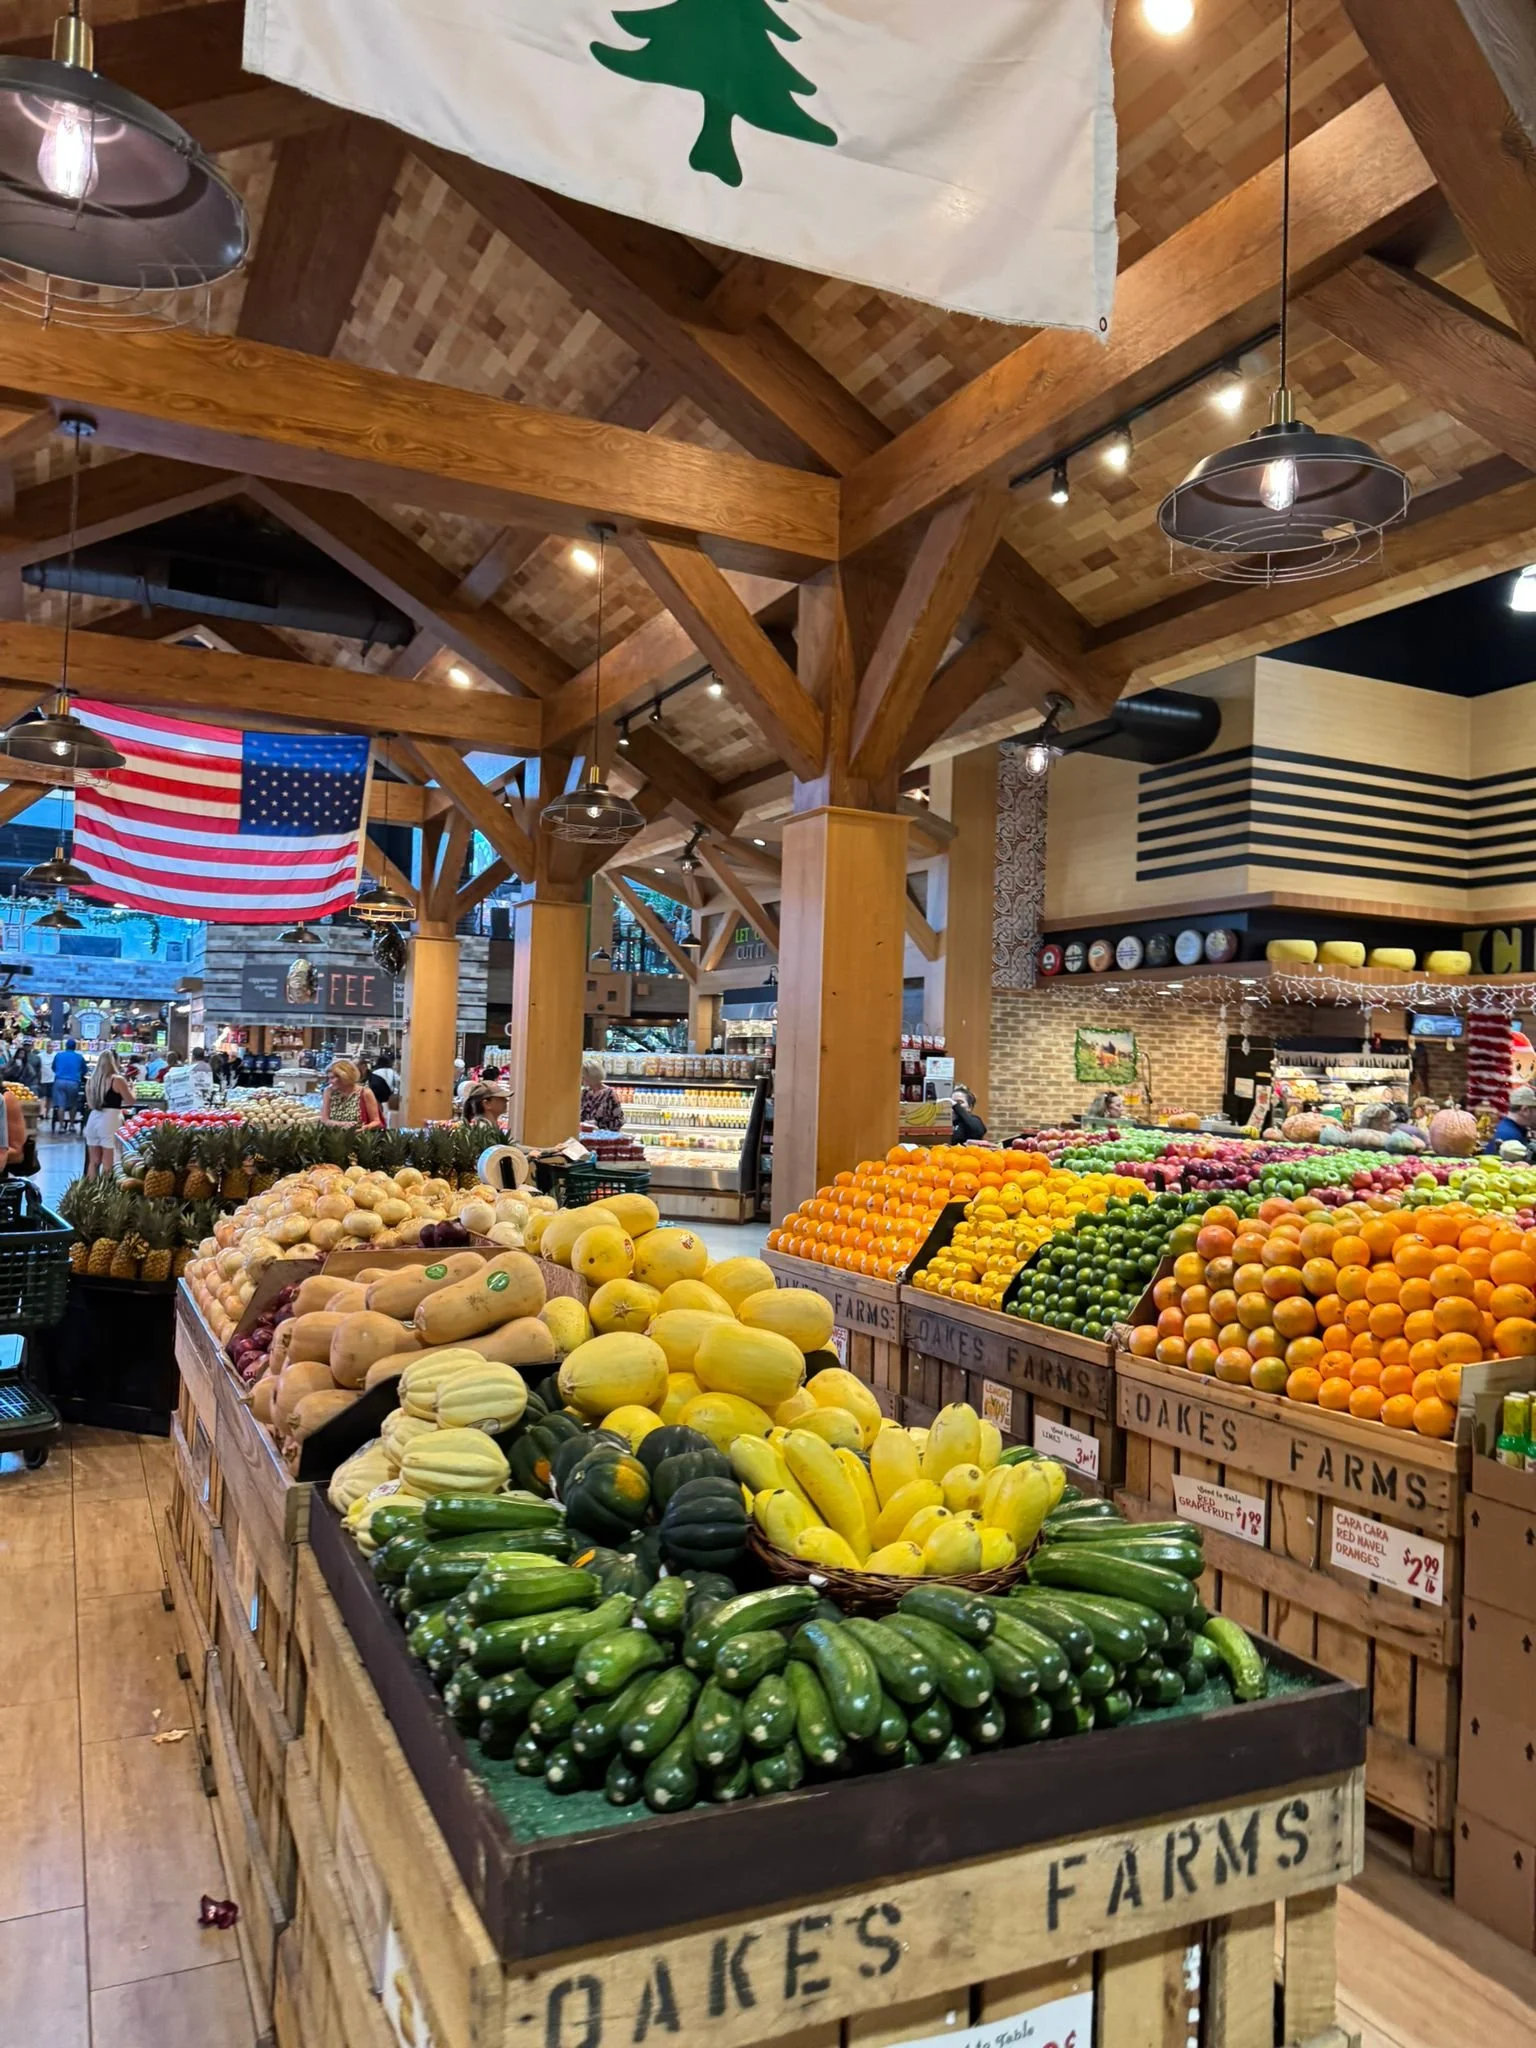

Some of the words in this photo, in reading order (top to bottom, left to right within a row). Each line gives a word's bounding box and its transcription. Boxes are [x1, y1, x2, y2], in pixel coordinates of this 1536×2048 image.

[735, 927, 749, 943] LET
[834, 1292, 891, 1330] FARMS
[918, 1318, 985, 1362] OAKES
[1006, 1345, 1091, 1400] FARMS
[1135, 1391, 1238, 1452] OAKES
[1289, 1437, 1429, 1511] FARMS
[1178, 1496, 1235, 1522] GRAPEFRUIT
[1197, 1494, 1216, 1507] RED
[1336, 1513, 1362, 1531] CARA
[1363, 1523, 1389, 1542] CARA
[1336, 1527, 1356, 1543] RED
[1357, 1535, 1387, 1557] NAVEL
[1335, 1542, 1380, 1568] ORANGES
[545, 1902, 903, 2048] OAKES
[1047, 1800, 1310, 1933] FARMS
[995, 2019, 1035, 2047] Table
